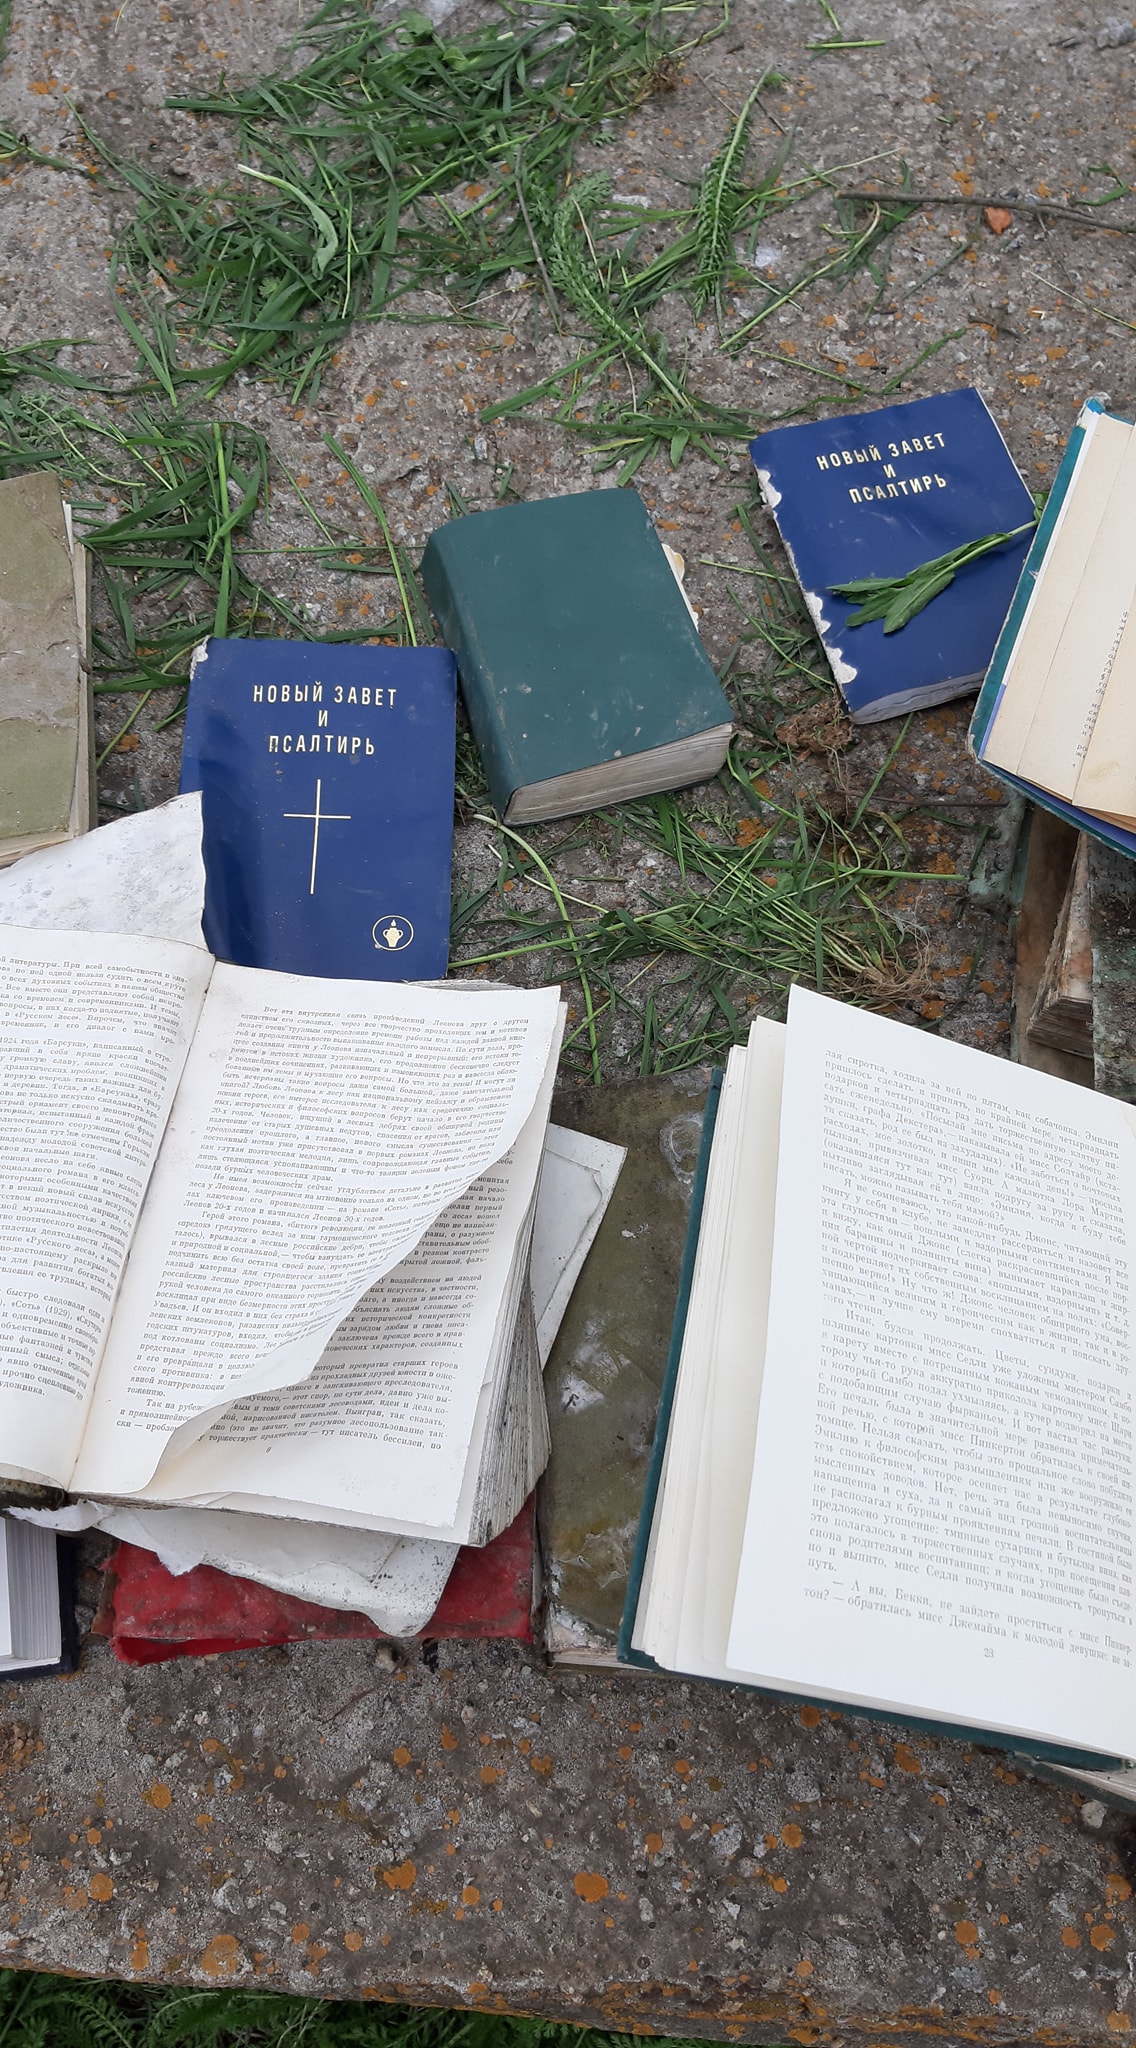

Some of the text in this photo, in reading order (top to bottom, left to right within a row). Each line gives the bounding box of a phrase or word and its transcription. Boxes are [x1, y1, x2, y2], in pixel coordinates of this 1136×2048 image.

[816, 433, 945, 470] НОВЫЙ ЗАВЕТ
[883, 464, 896, 478] И
[848, 474, 947, 503] ПСАЛТИРЬ
[253, 680, 397, 706] НОВЫЙ ЗАВЕТ
[317, 710, 328, 727] И
[268, 734, 375, 755] ПСАЛТИРЬ
